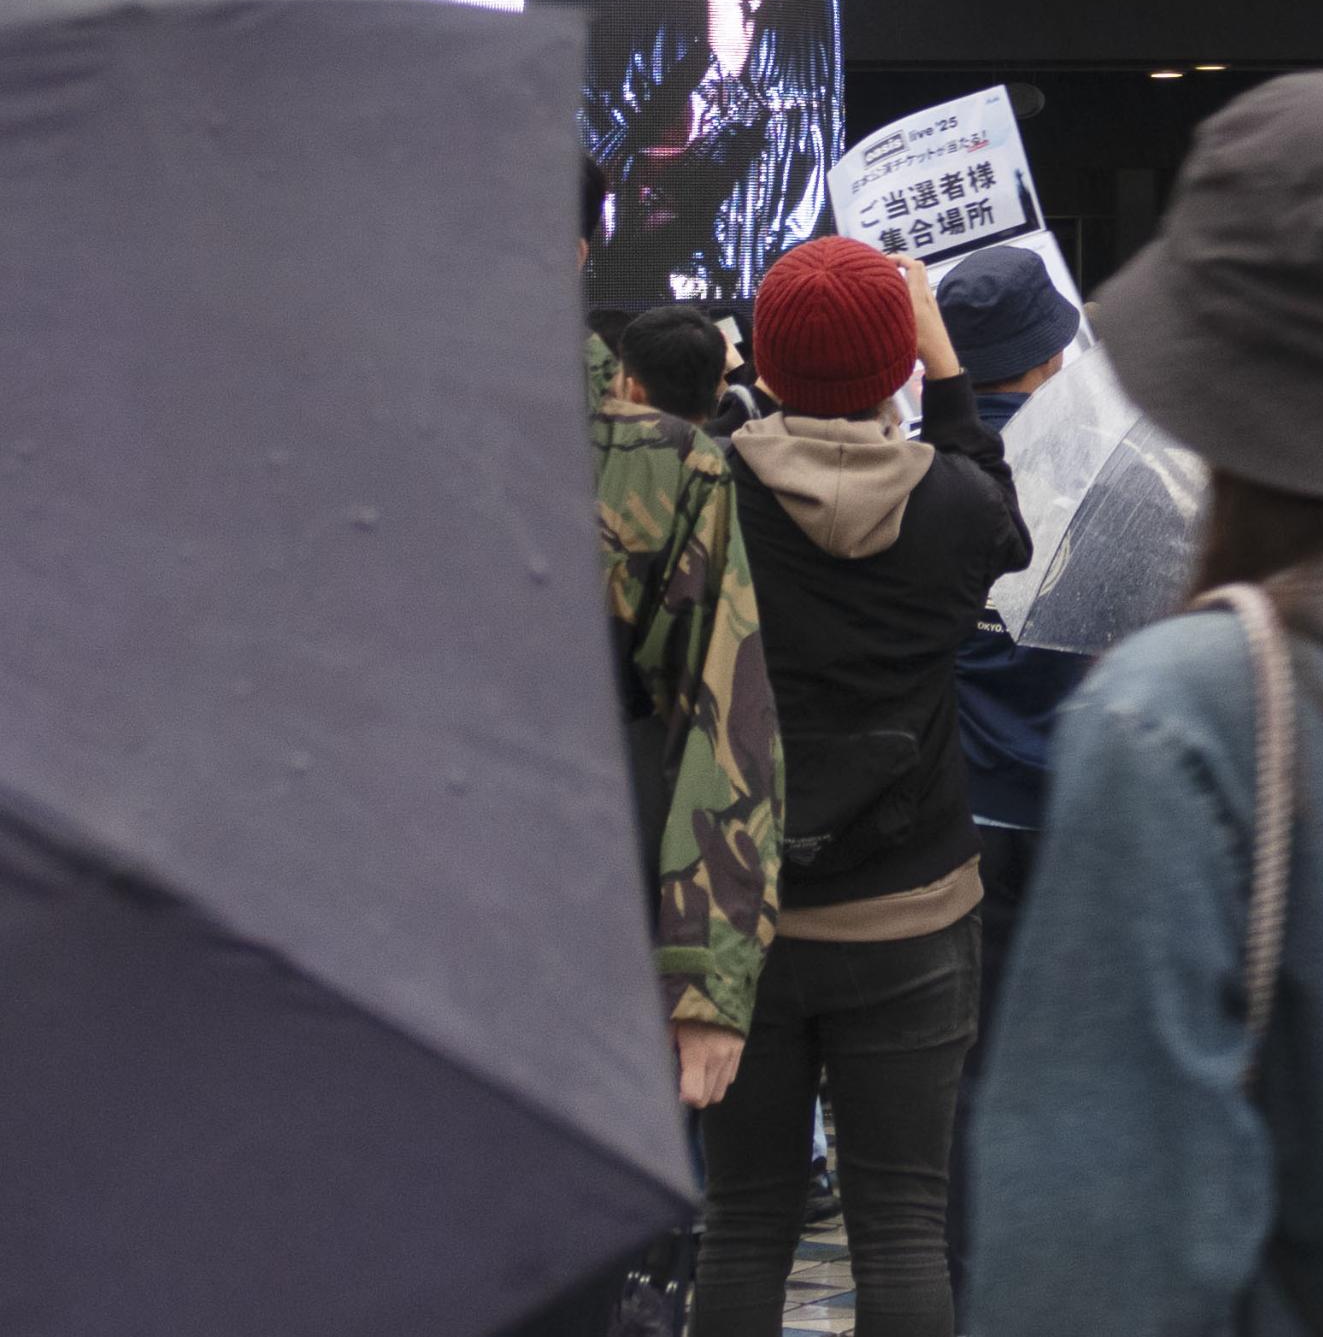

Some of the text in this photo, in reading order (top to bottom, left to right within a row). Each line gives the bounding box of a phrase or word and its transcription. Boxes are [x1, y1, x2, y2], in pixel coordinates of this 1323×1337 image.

[859, 161, 997, 229] ご当選者様
[878, 197, 995, 255] 集合場所
